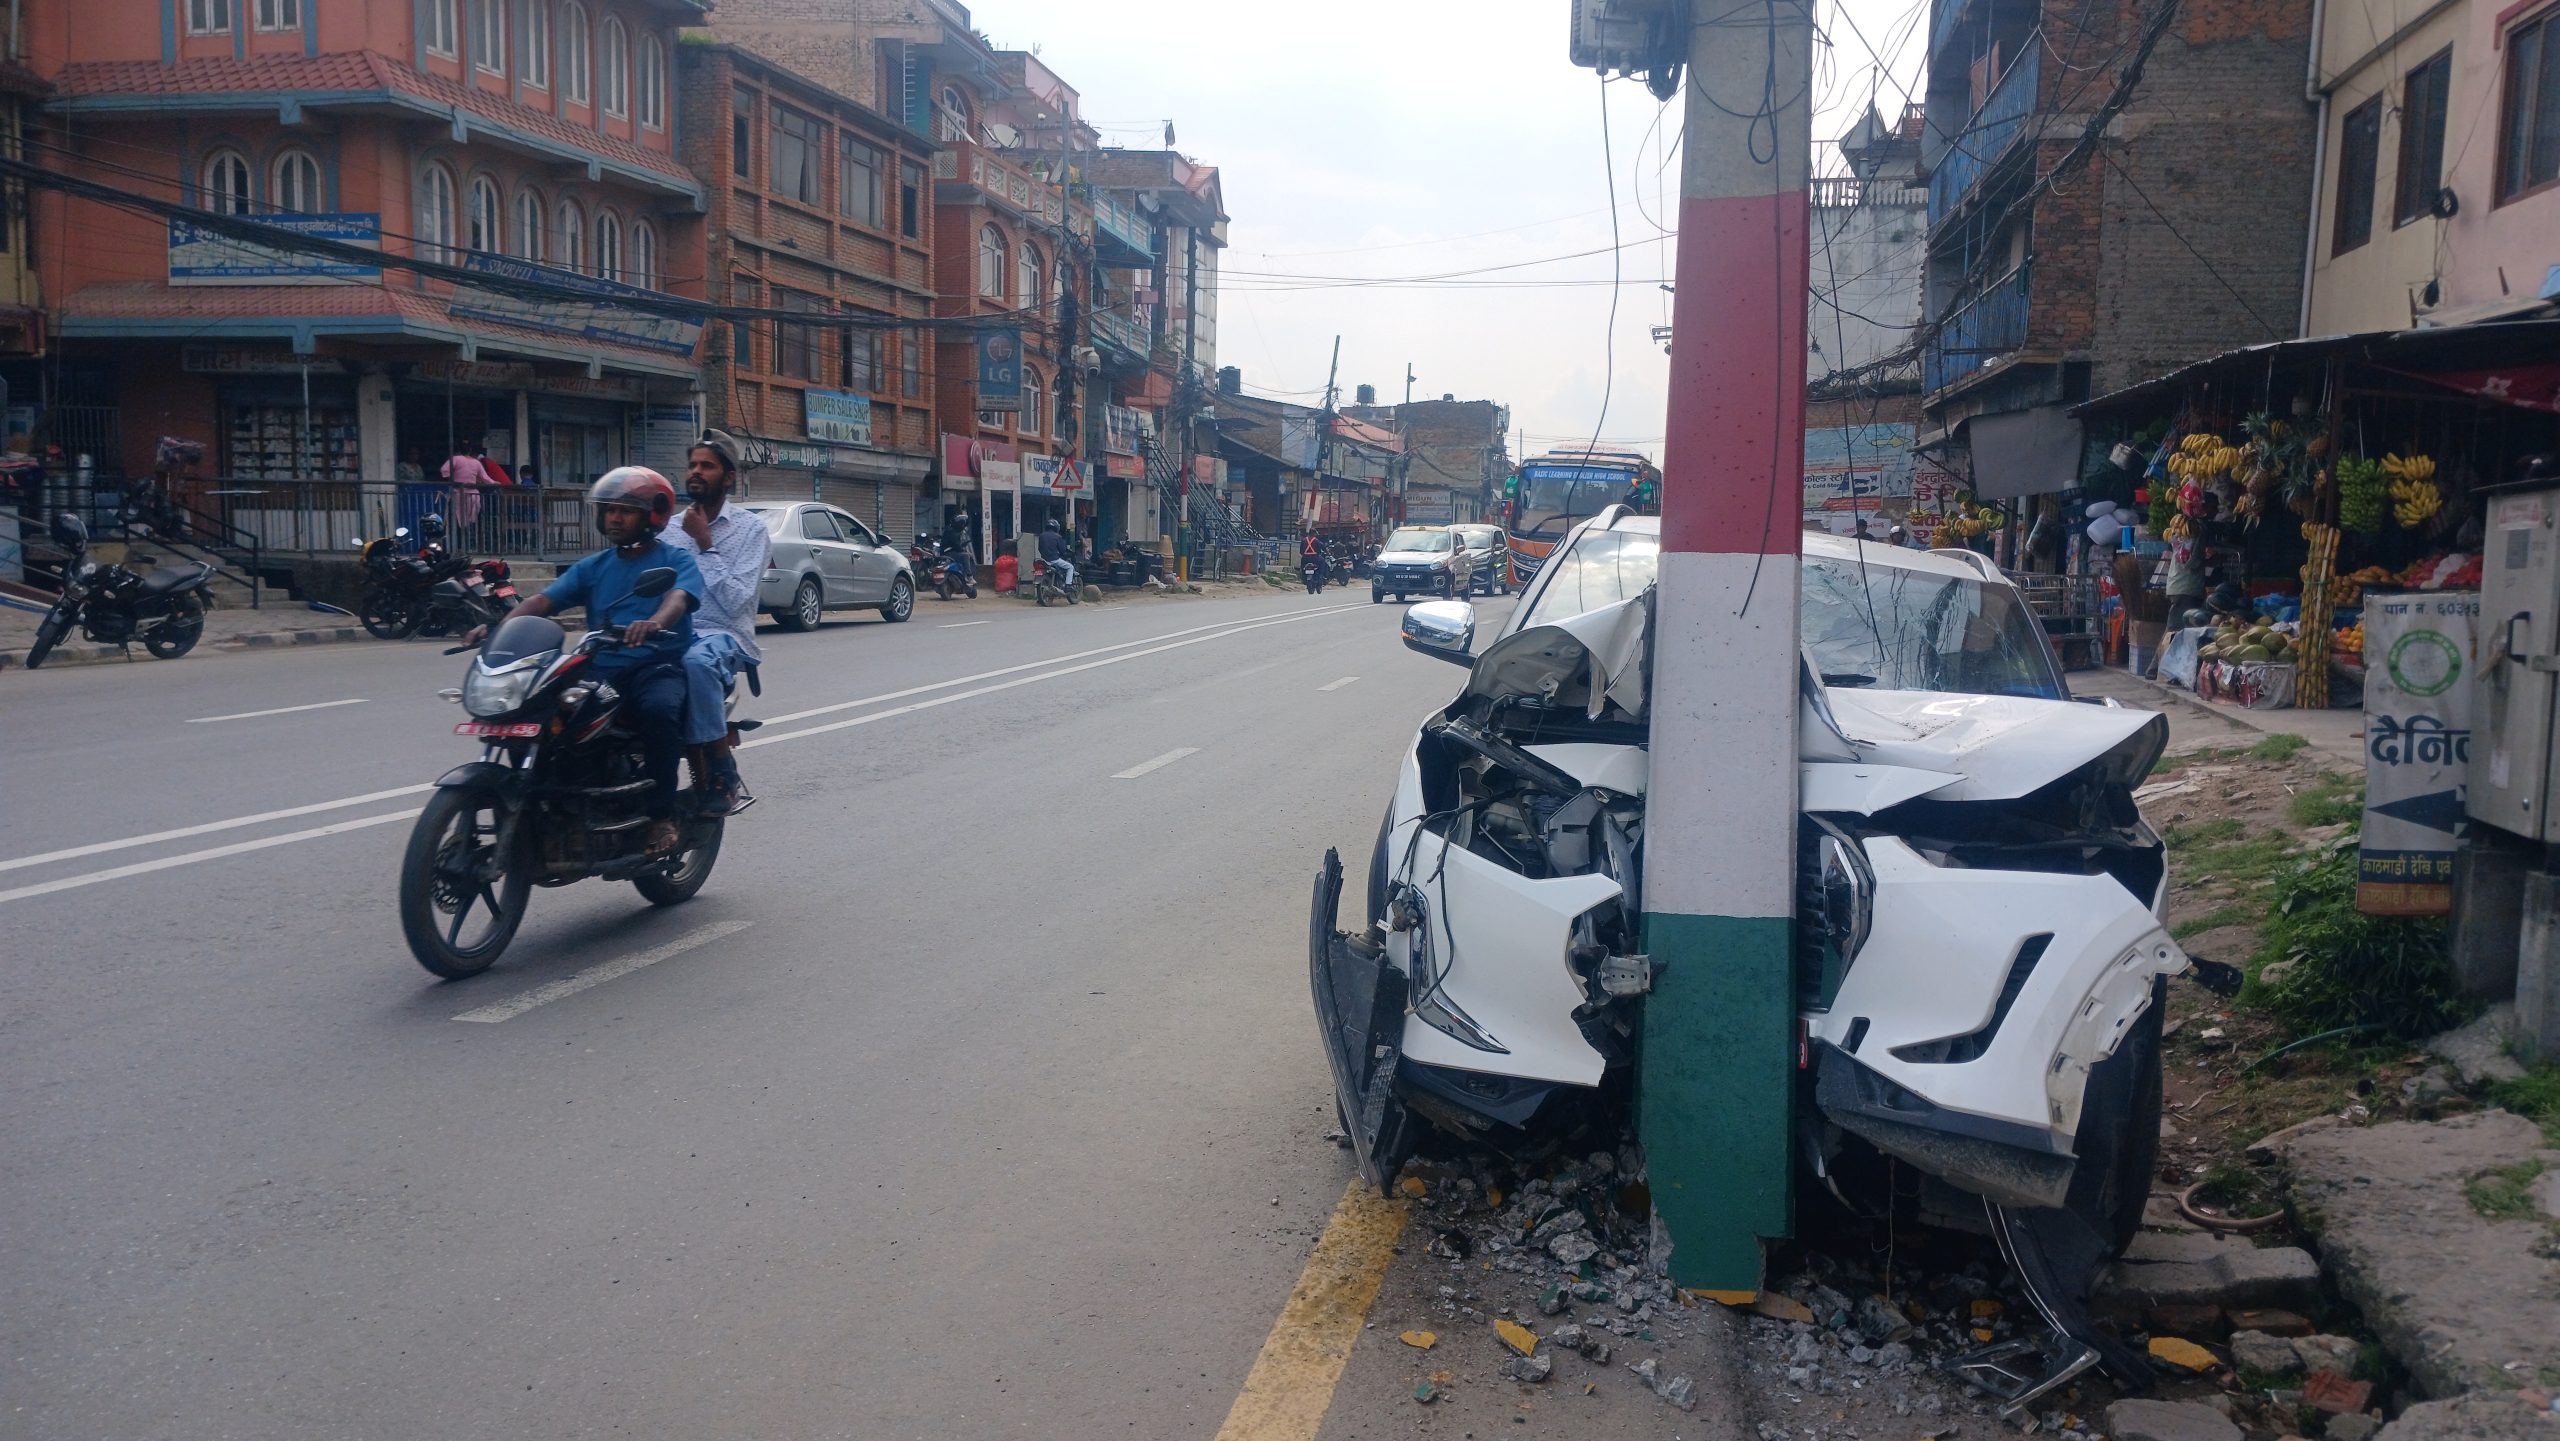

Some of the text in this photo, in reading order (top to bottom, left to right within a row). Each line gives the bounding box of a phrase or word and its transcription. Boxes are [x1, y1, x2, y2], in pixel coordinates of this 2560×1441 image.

[988, 367, 1011, 382] LG
[808, 394, 870, 422] BUMPER SALE SHOP
[1534, 470, 1548, 478] BASIC
[1548, 471, 1573, 479] LEARNING
[1594, 472, 1607, 480] HIGH
[1607, 472, 1626, 481] SCHOOL
[2383, 603, 2408, 615] पान
